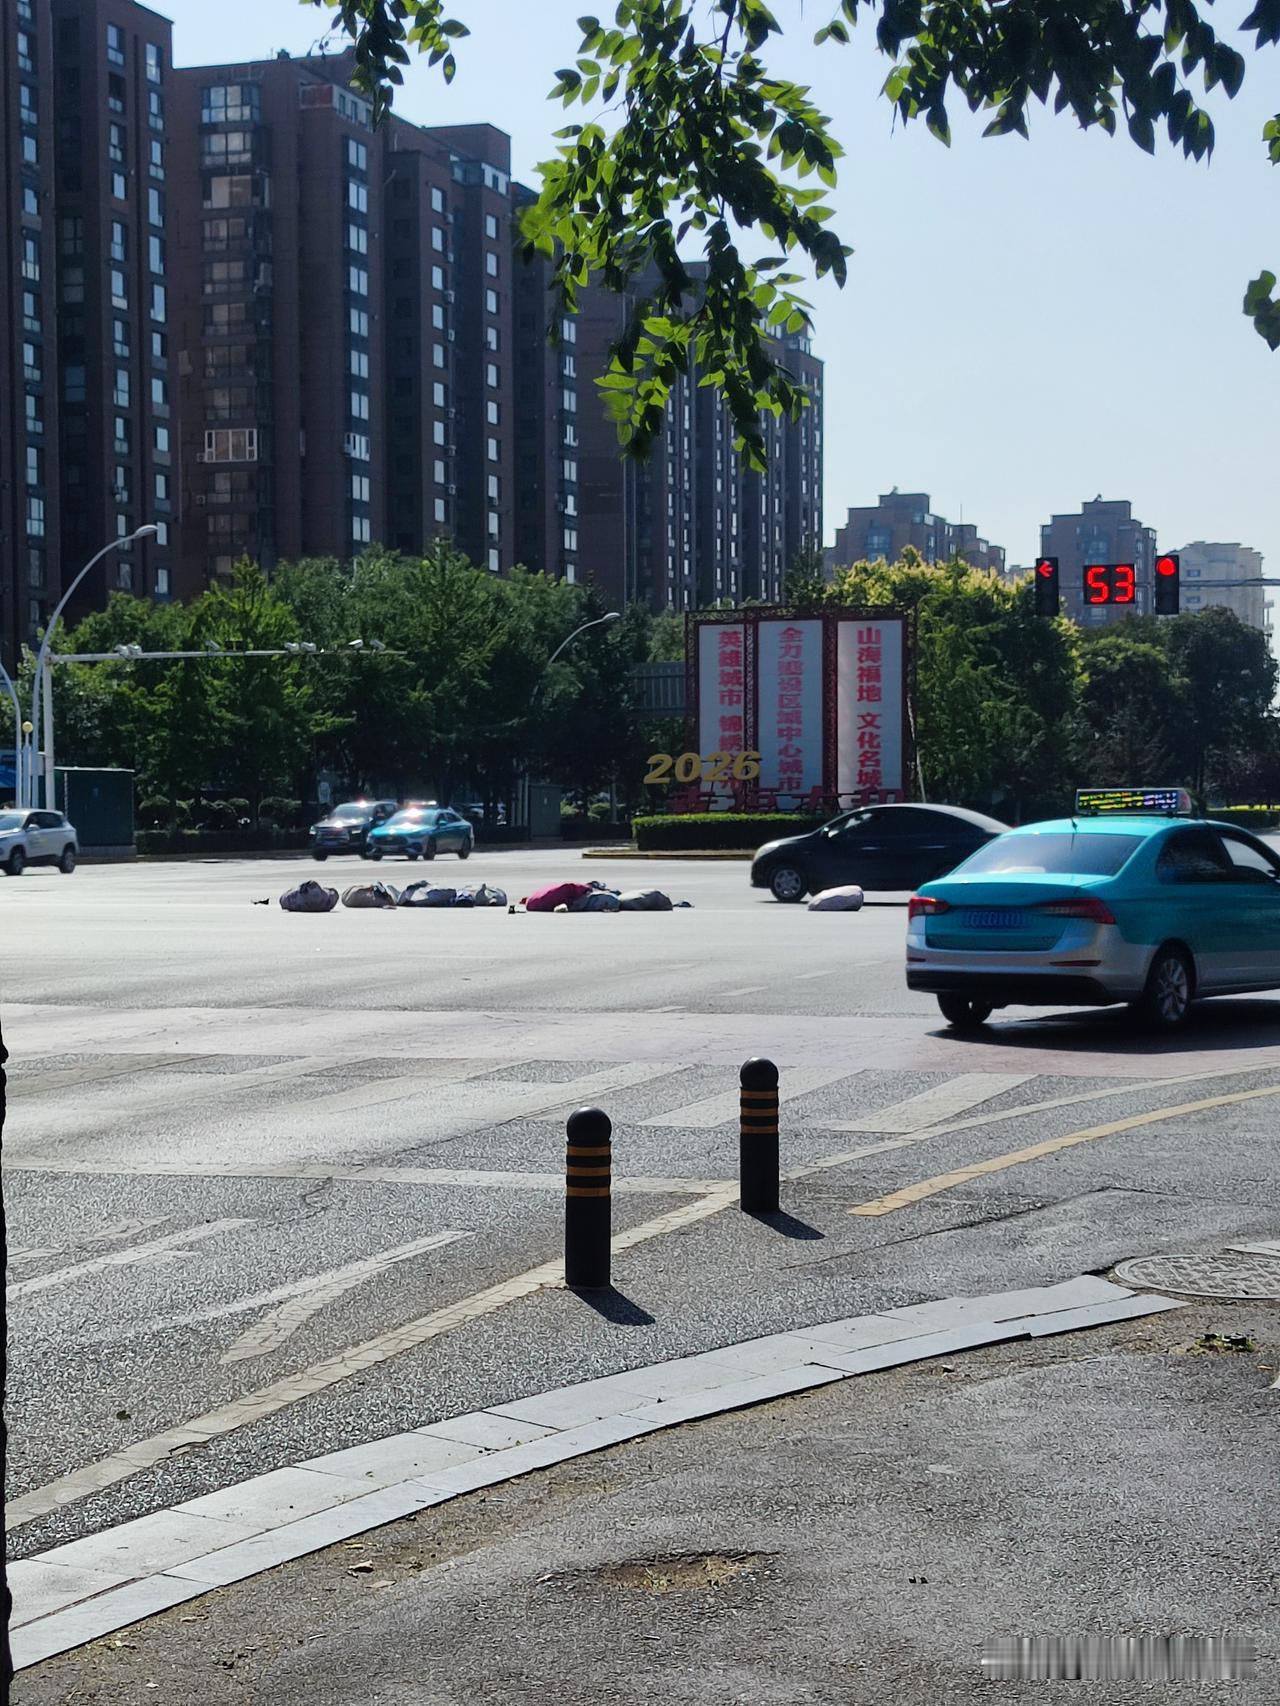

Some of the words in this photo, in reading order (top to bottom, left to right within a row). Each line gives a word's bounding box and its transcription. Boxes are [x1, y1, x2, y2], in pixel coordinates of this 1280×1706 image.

[1087, 566, 1135, 604] 53
[718, 630, 743, 707] 英雄城市
[856, 626, 882, 703] 山海福地
[777, 626, 804, 791] 全力建设区域中心城市
[643, 751, 761, 785] 2026
[856, 712, 882, 788] 文化名城
